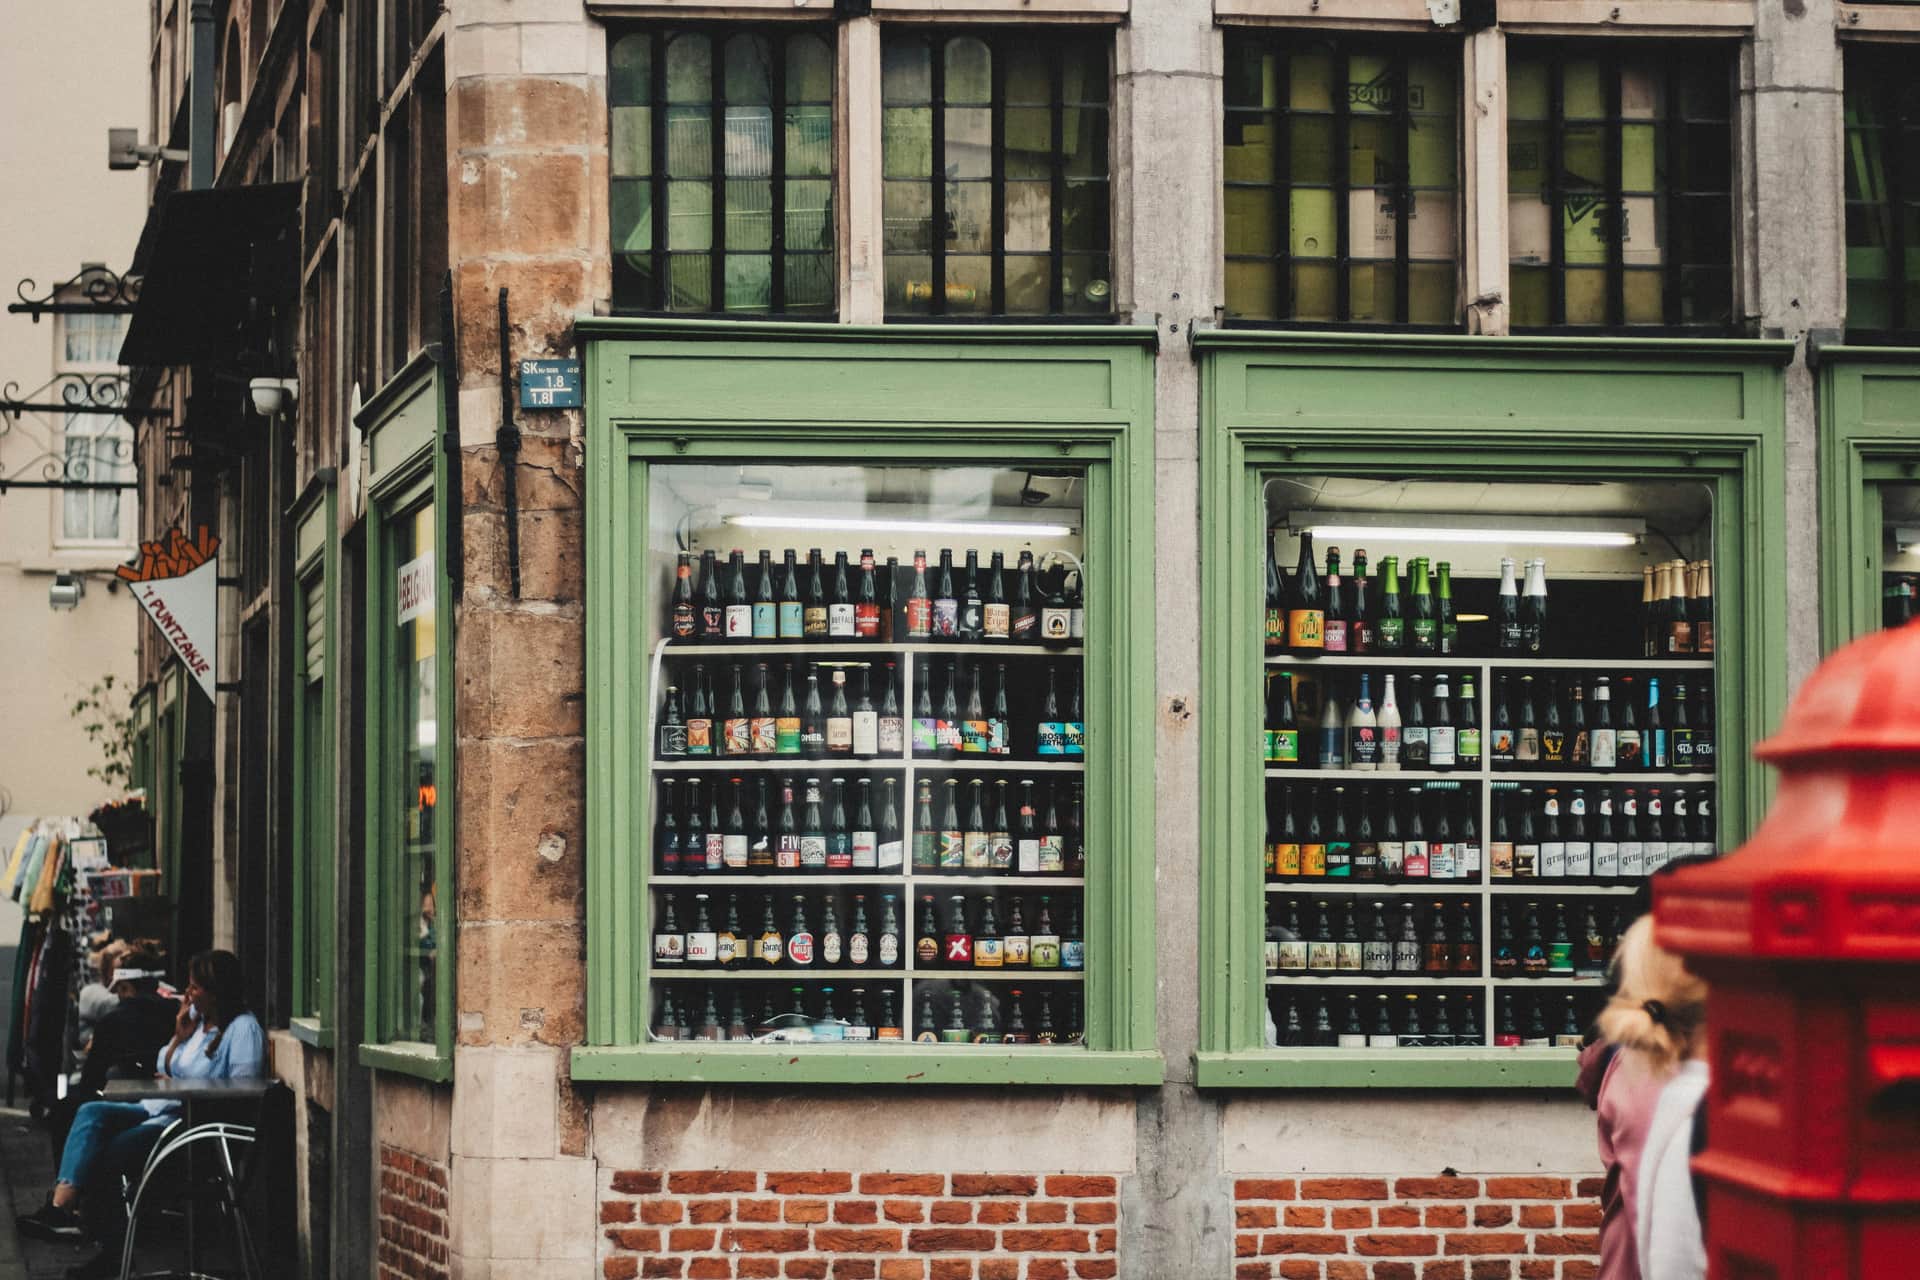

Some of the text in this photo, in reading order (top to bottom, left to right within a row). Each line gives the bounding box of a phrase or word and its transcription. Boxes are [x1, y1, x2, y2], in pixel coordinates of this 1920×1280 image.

[522, 362, 539, 374] SK
[546, 375, 564, 388] 1.8
[148, 598, 210, 677] PUNTZAKJE
